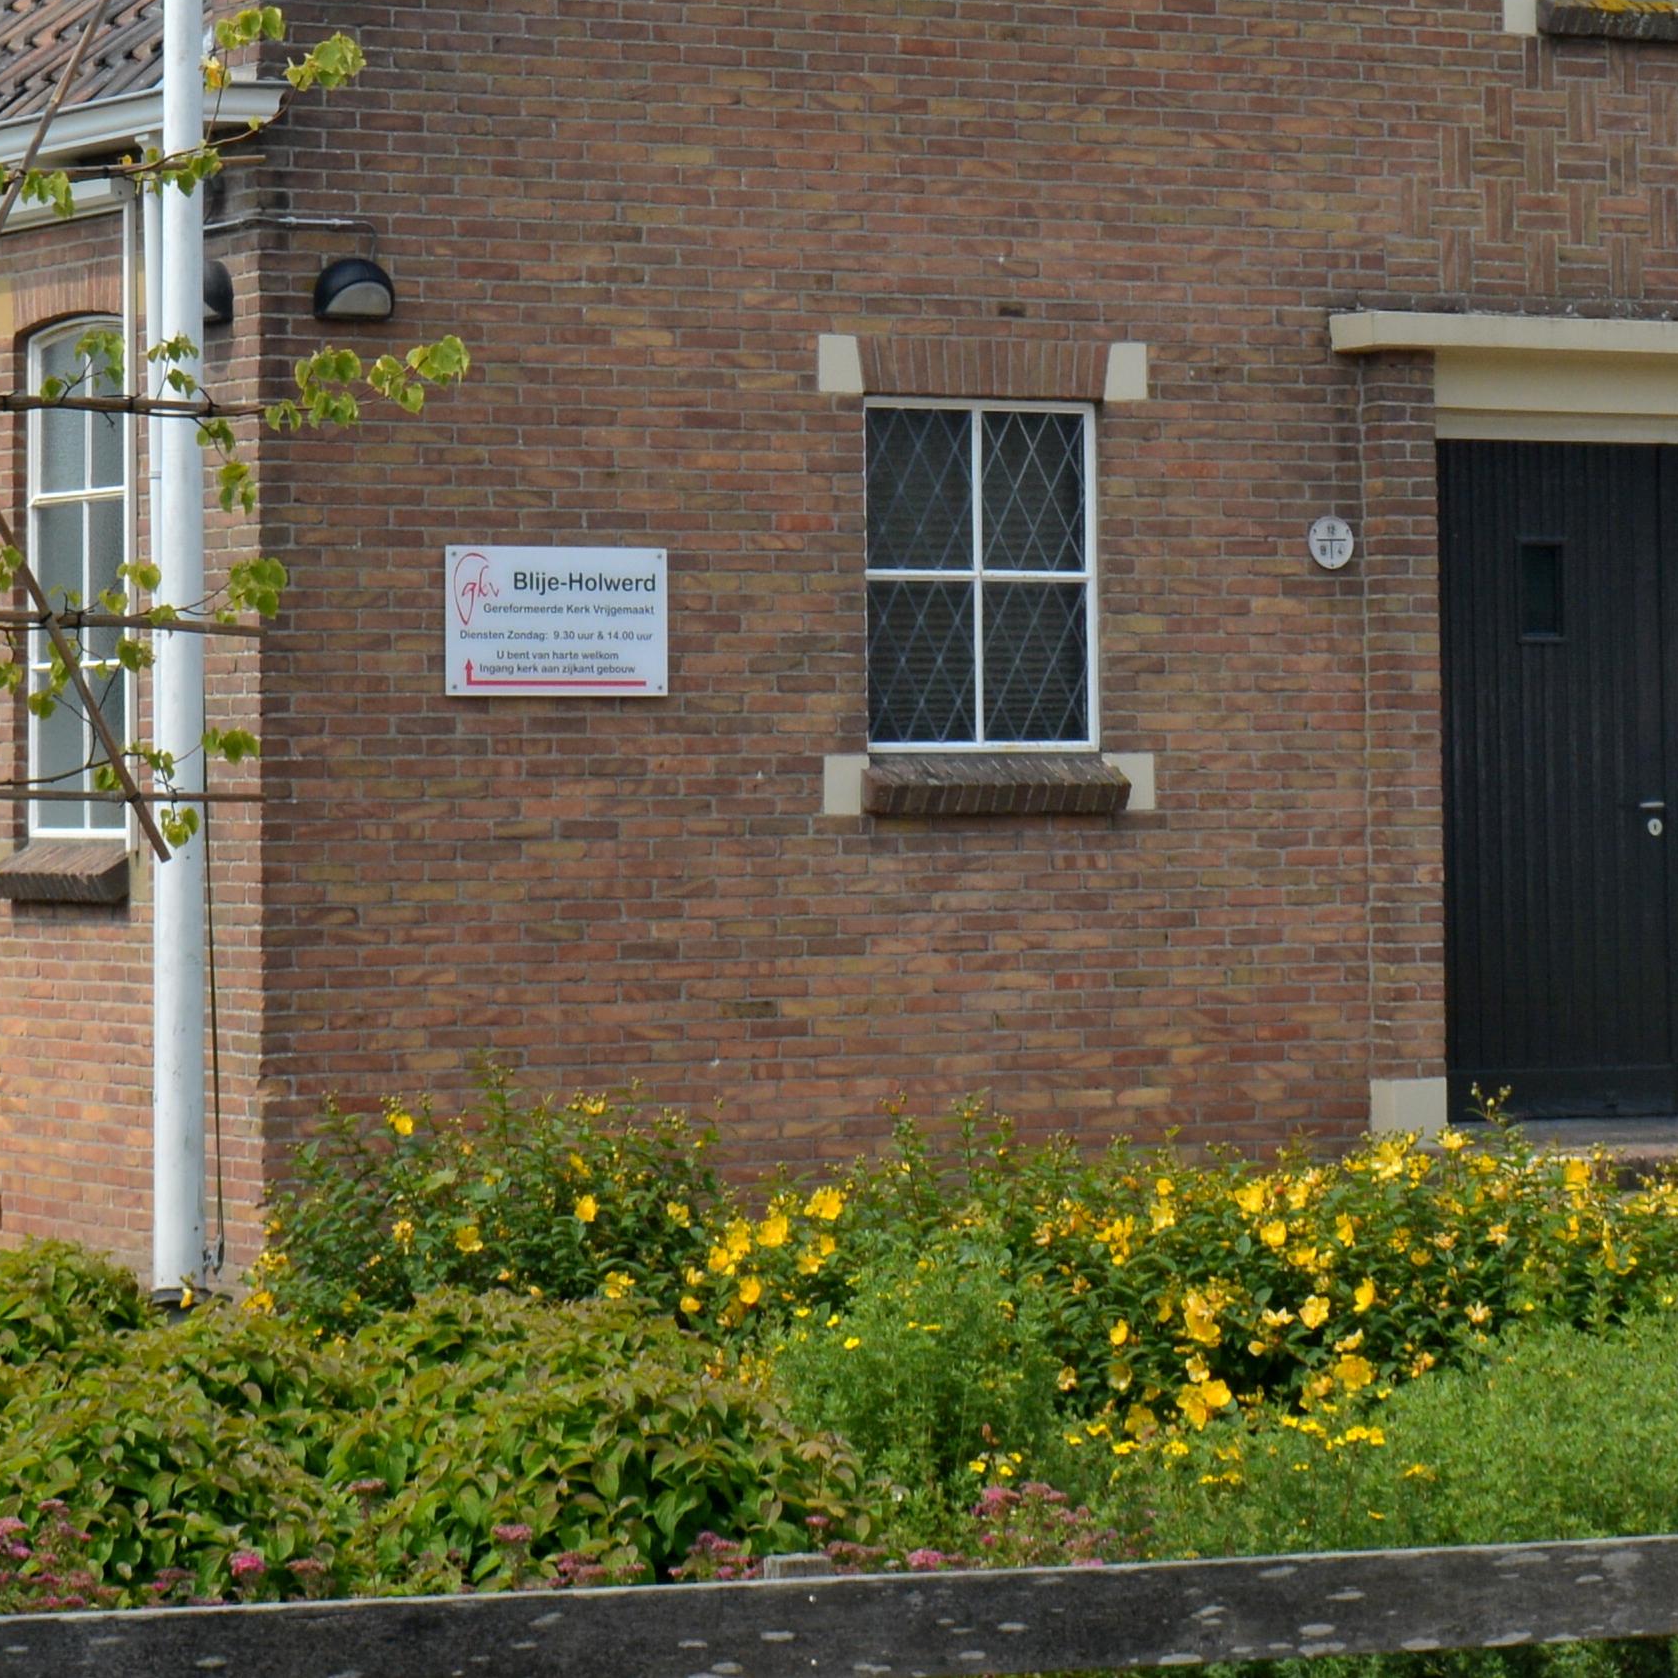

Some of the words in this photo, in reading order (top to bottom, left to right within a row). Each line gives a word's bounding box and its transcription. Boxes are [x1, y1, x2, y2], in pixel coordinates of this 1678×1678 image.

[514, 571, 656, 596] Blije-Holwerd
[483, 603, 564, 614] Gereformeerde
[566, 604, 590, 614] Kerk
[594, 604, 655, 617] Vrijgemaakt
[459, 629, 505, 639] Diensten
[507, 630, 548, 642] Zondag:
[553, 630, 575, 640] 9.30
[577, 632, 594, 640] uur
[597, 630, 604, 640] &
[608, 630, 634, 640] 14.00
[636, 632, 653, 641] uur
[496, 650, 504, 659] U
[507, 650, 530, 659] bent
[532, 652, 550, 660] van
[552, 650, 579, 659] harte
[581, 650, 619, 660] welkom
[479, 663, 514, 675] Ingang
[516, 663, 538, 673] kerk
[541, 665, 560, 673] aan
[562, 663, 595, 675] zijkant
[596, 664, 636, 675] gebouw
